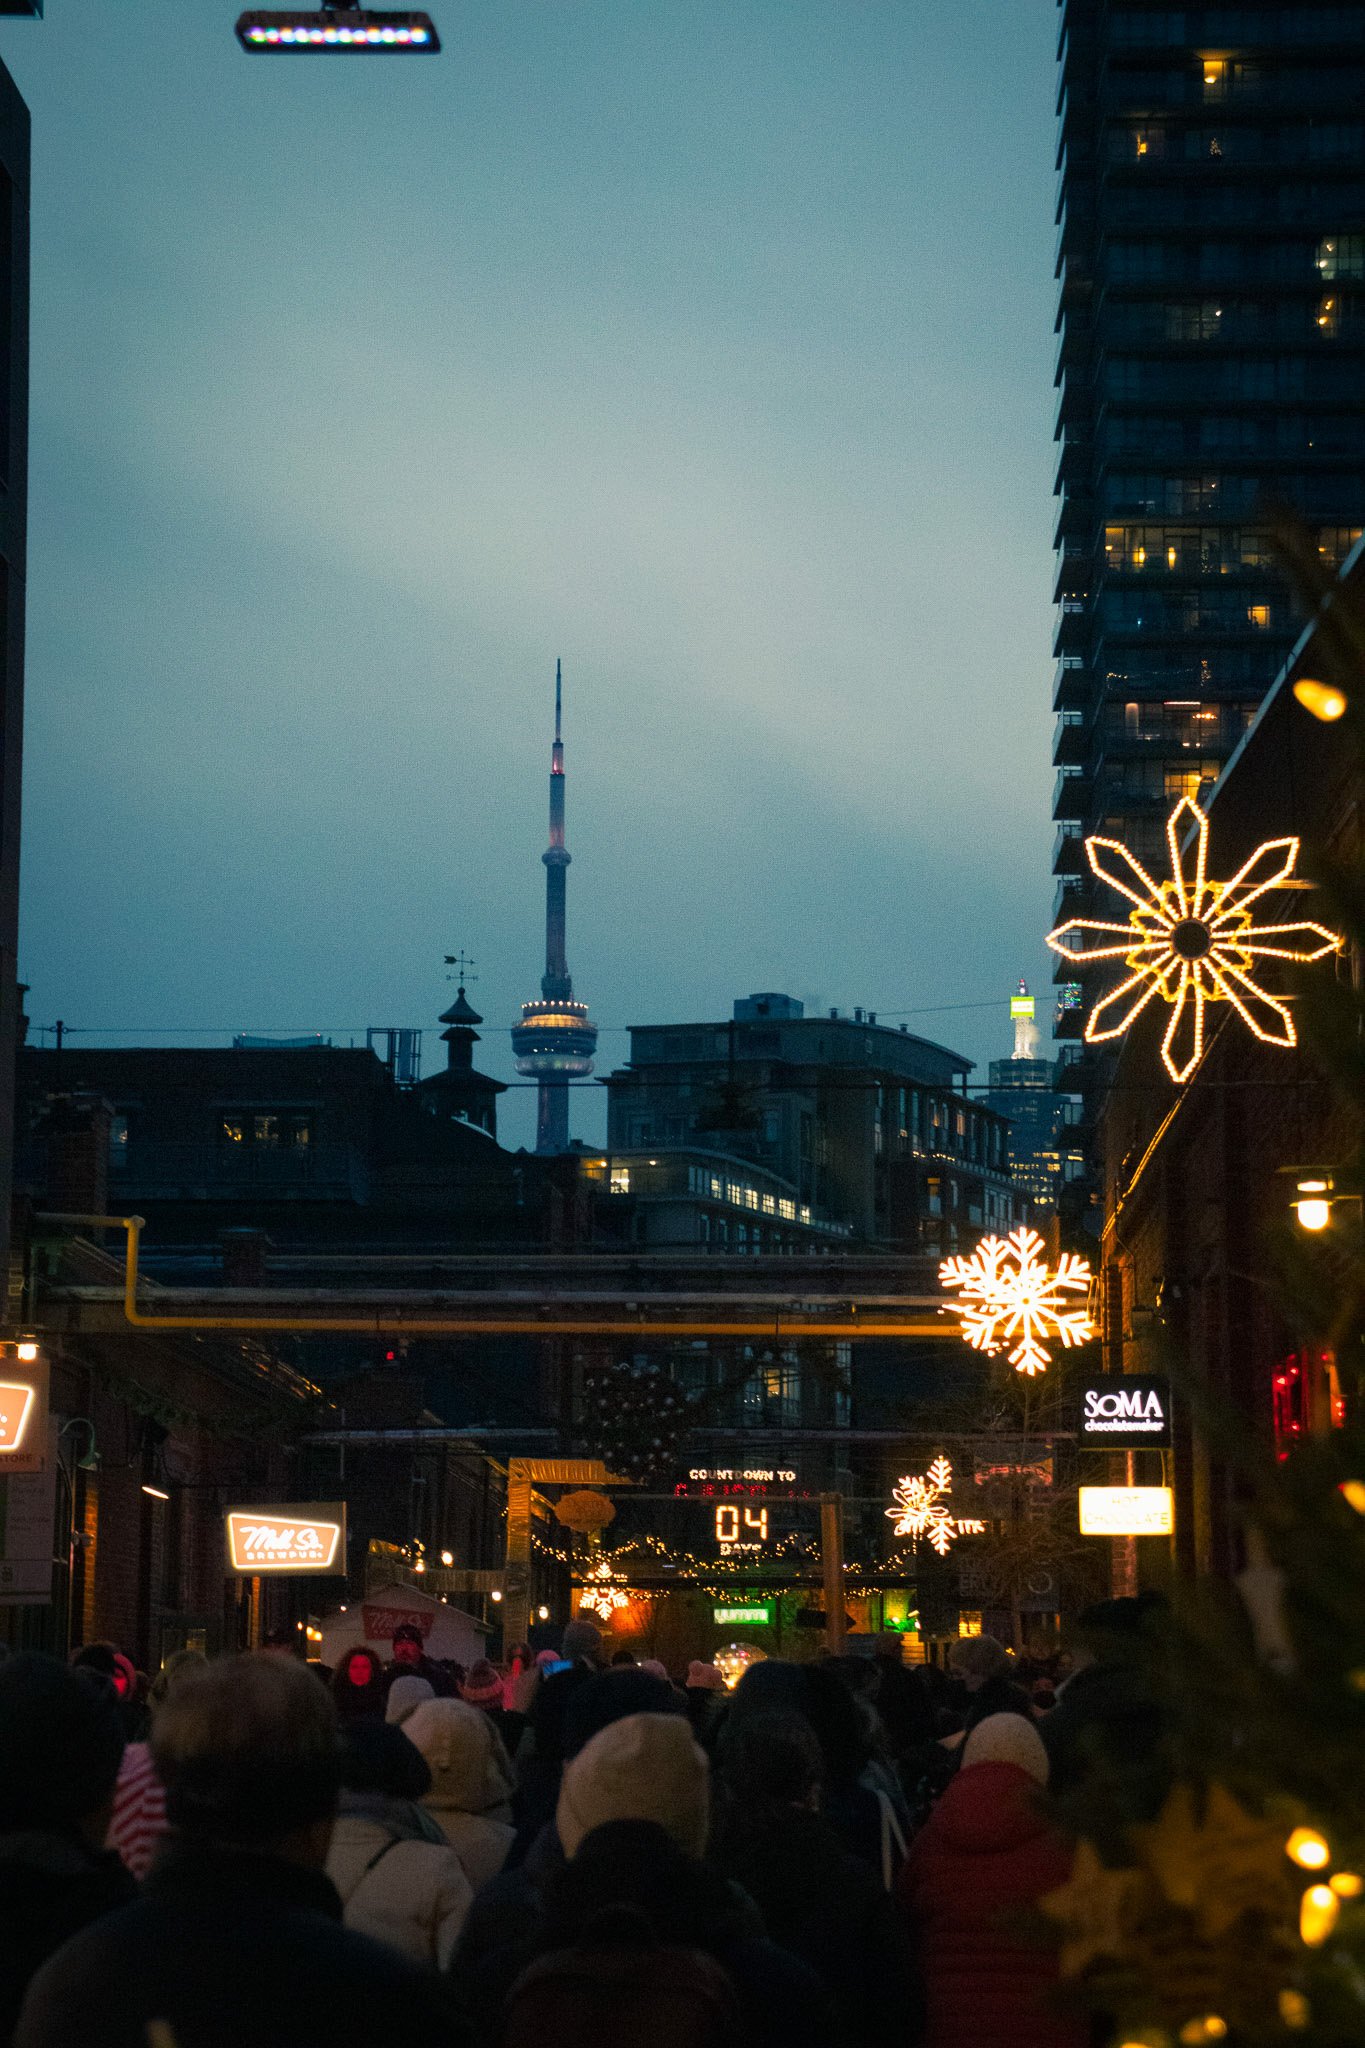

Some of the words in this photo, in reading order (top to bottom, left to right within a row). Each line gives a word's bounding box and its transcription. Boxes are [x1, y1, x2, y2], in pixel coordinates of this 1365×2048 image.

[1083, 1390, 1164, 1418] SOMA
[689, 1469, 774, 1481] COUNTDOWN
[776, 1470, 797, 1482] TO
[716, 1505, 768, 1541] 04
[239, 1526, 293, 1551] Mill
[720, 1542, 762, 1556] DAYS
